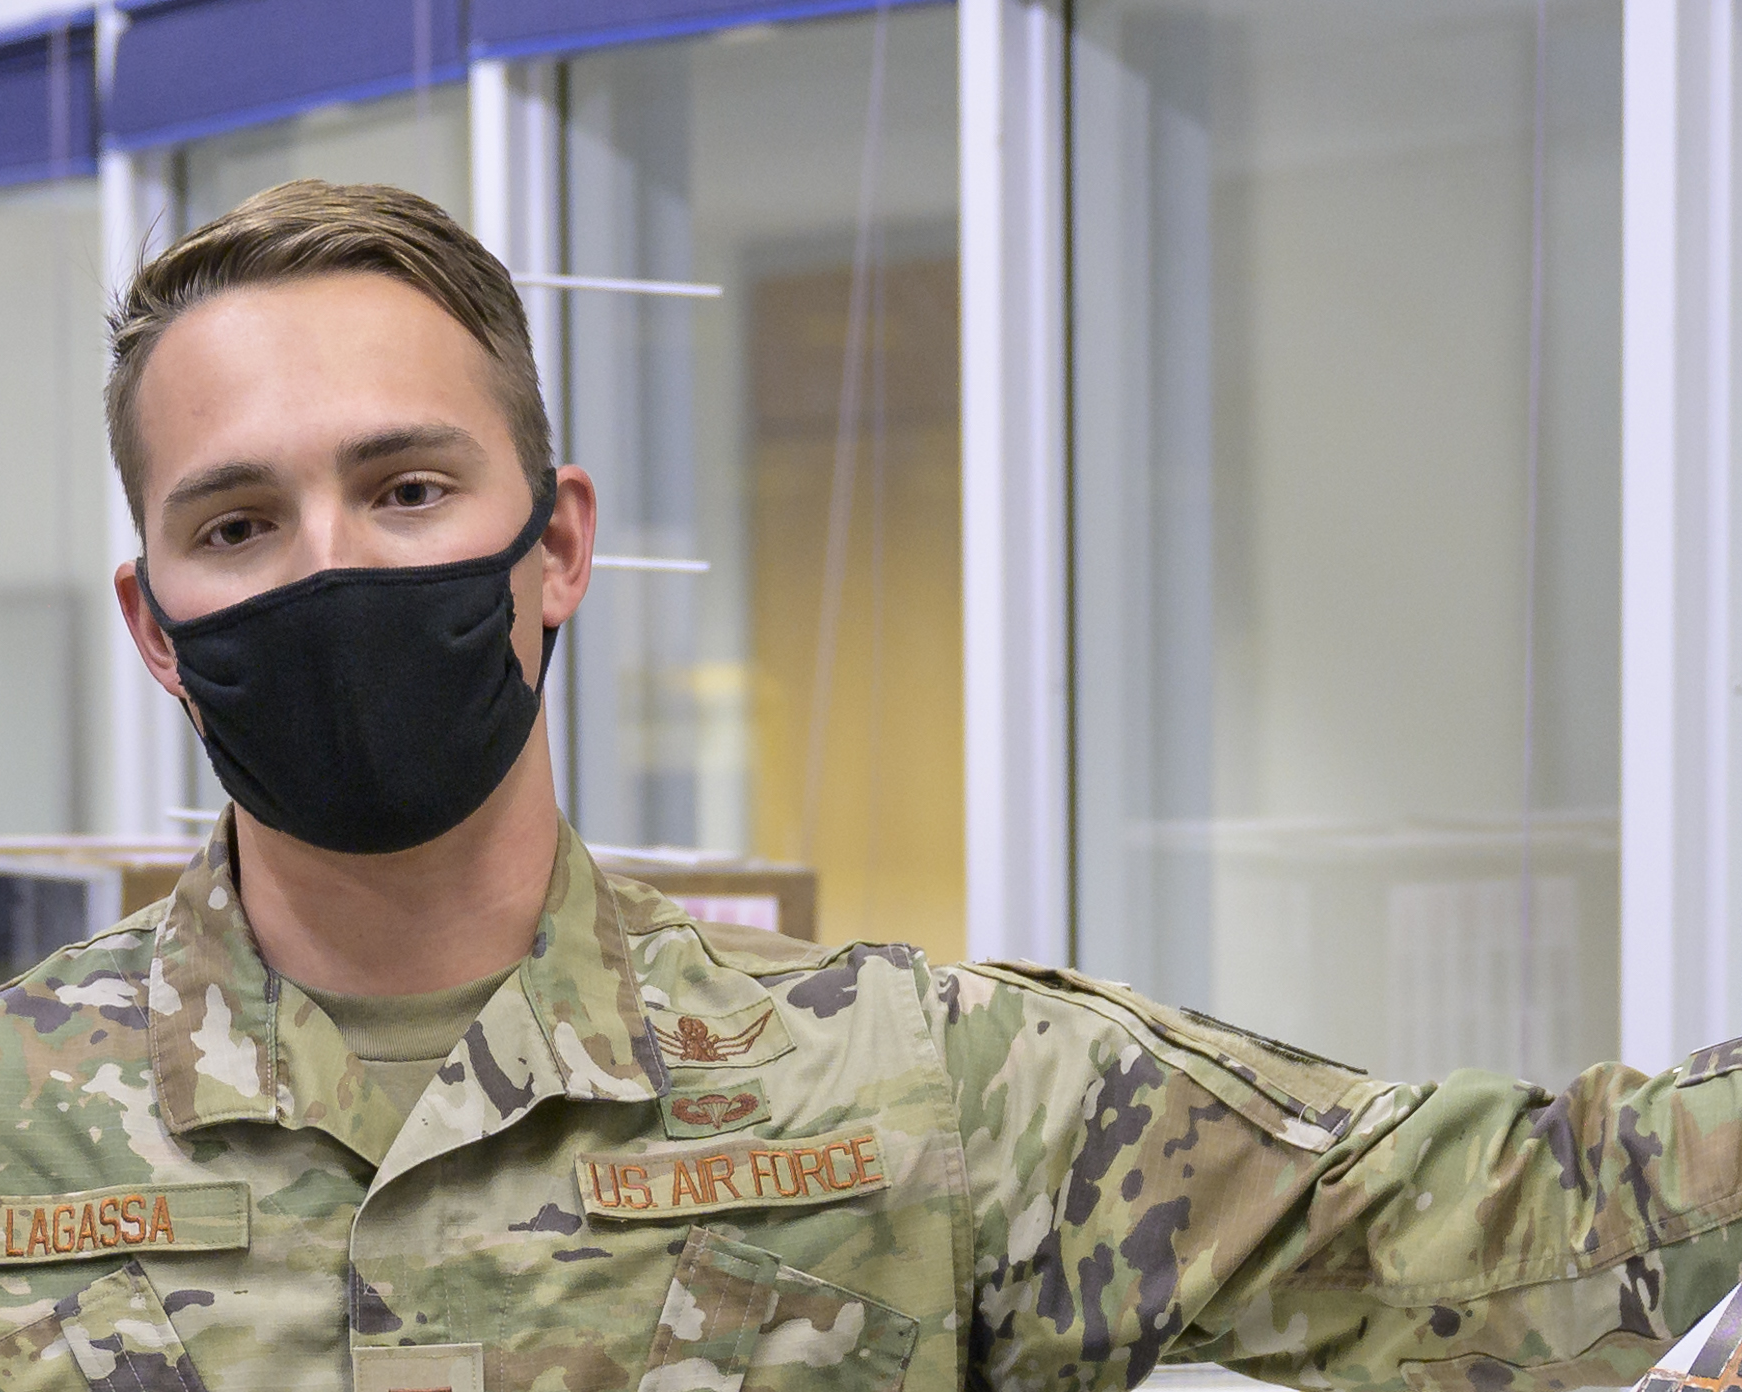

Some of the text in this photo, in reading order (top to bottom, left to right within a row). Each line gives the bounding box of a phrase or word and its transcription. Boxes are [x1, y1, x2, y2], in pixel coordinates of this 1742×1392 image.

[672, 1154, 743, 1206] AIR
[749, 1135, 884, 1198] FORCE
[5, 1194, 175, 1257] LAGASSA
